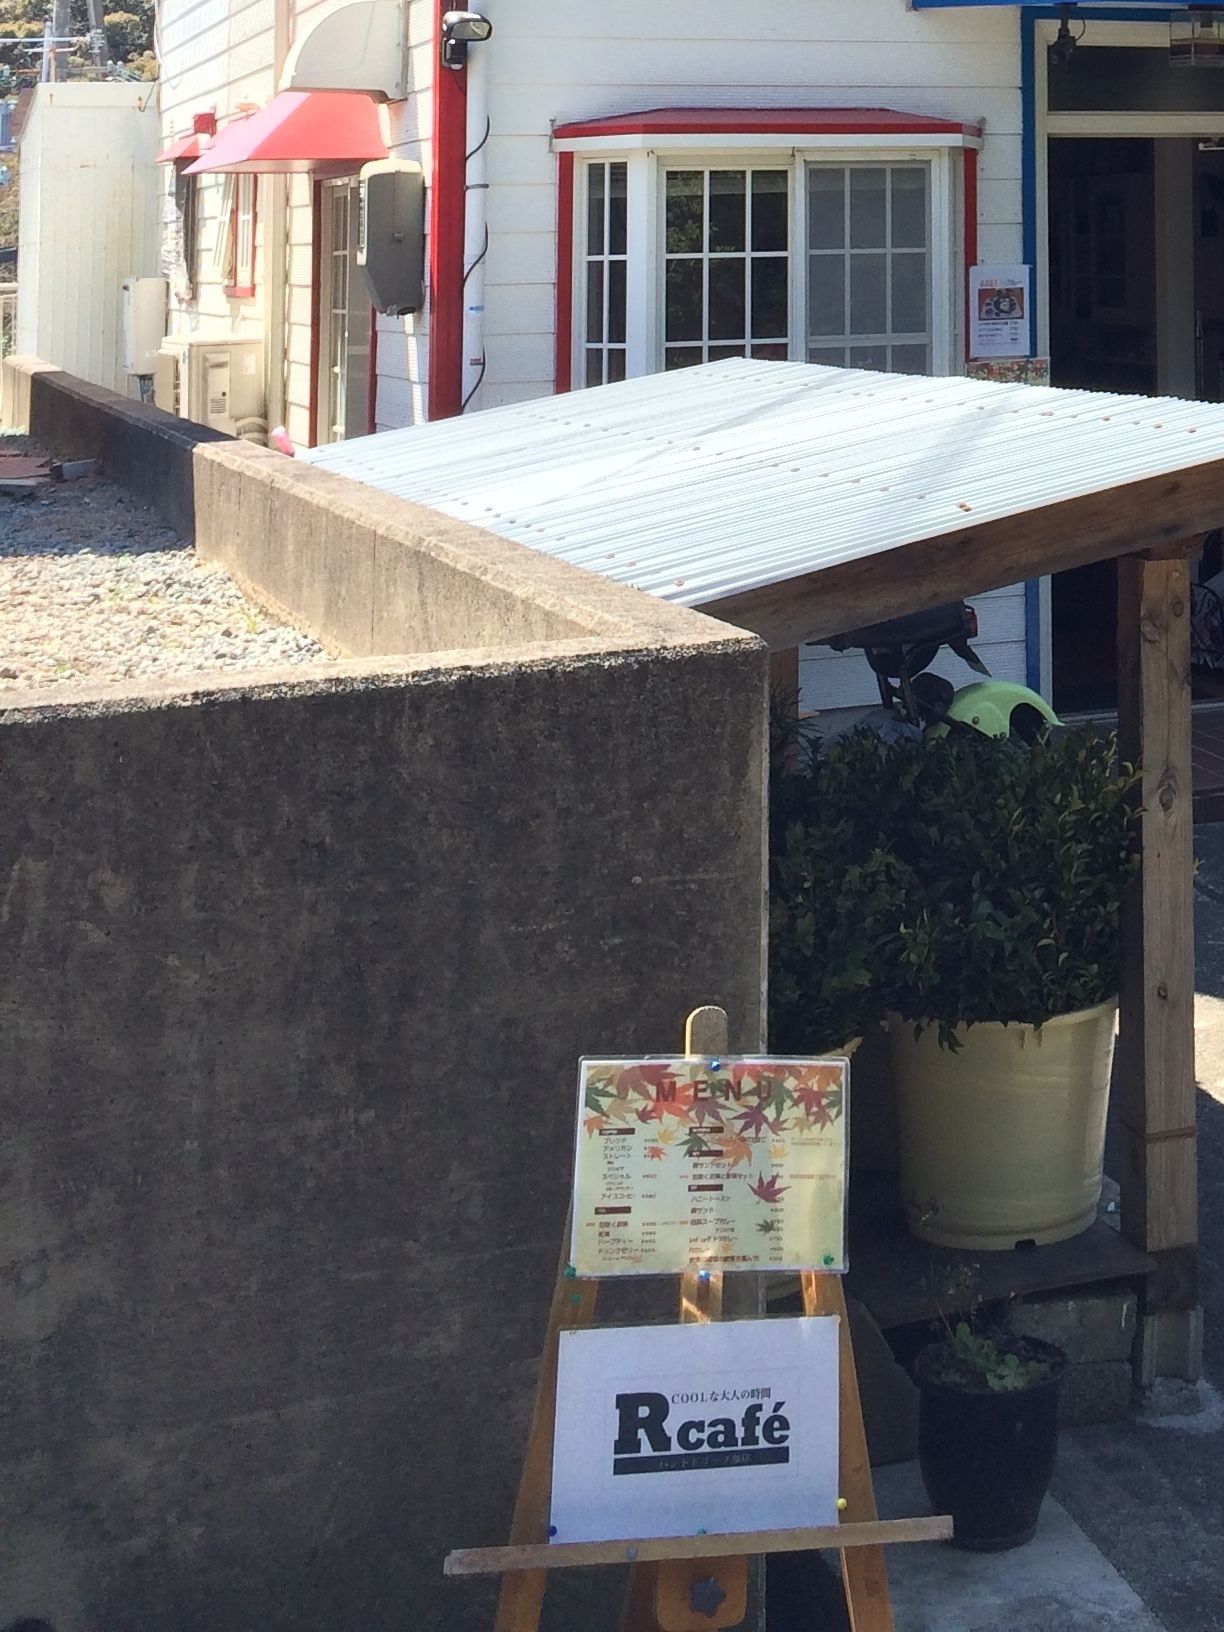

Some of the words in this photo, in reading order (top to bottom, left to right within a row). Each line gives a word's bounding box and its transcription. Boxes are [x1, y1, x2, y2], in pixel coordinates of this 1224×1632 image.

[656, 1079, 772, 1102] MENU
[671, 1387, 772, 1405] COOLな大人の時間
